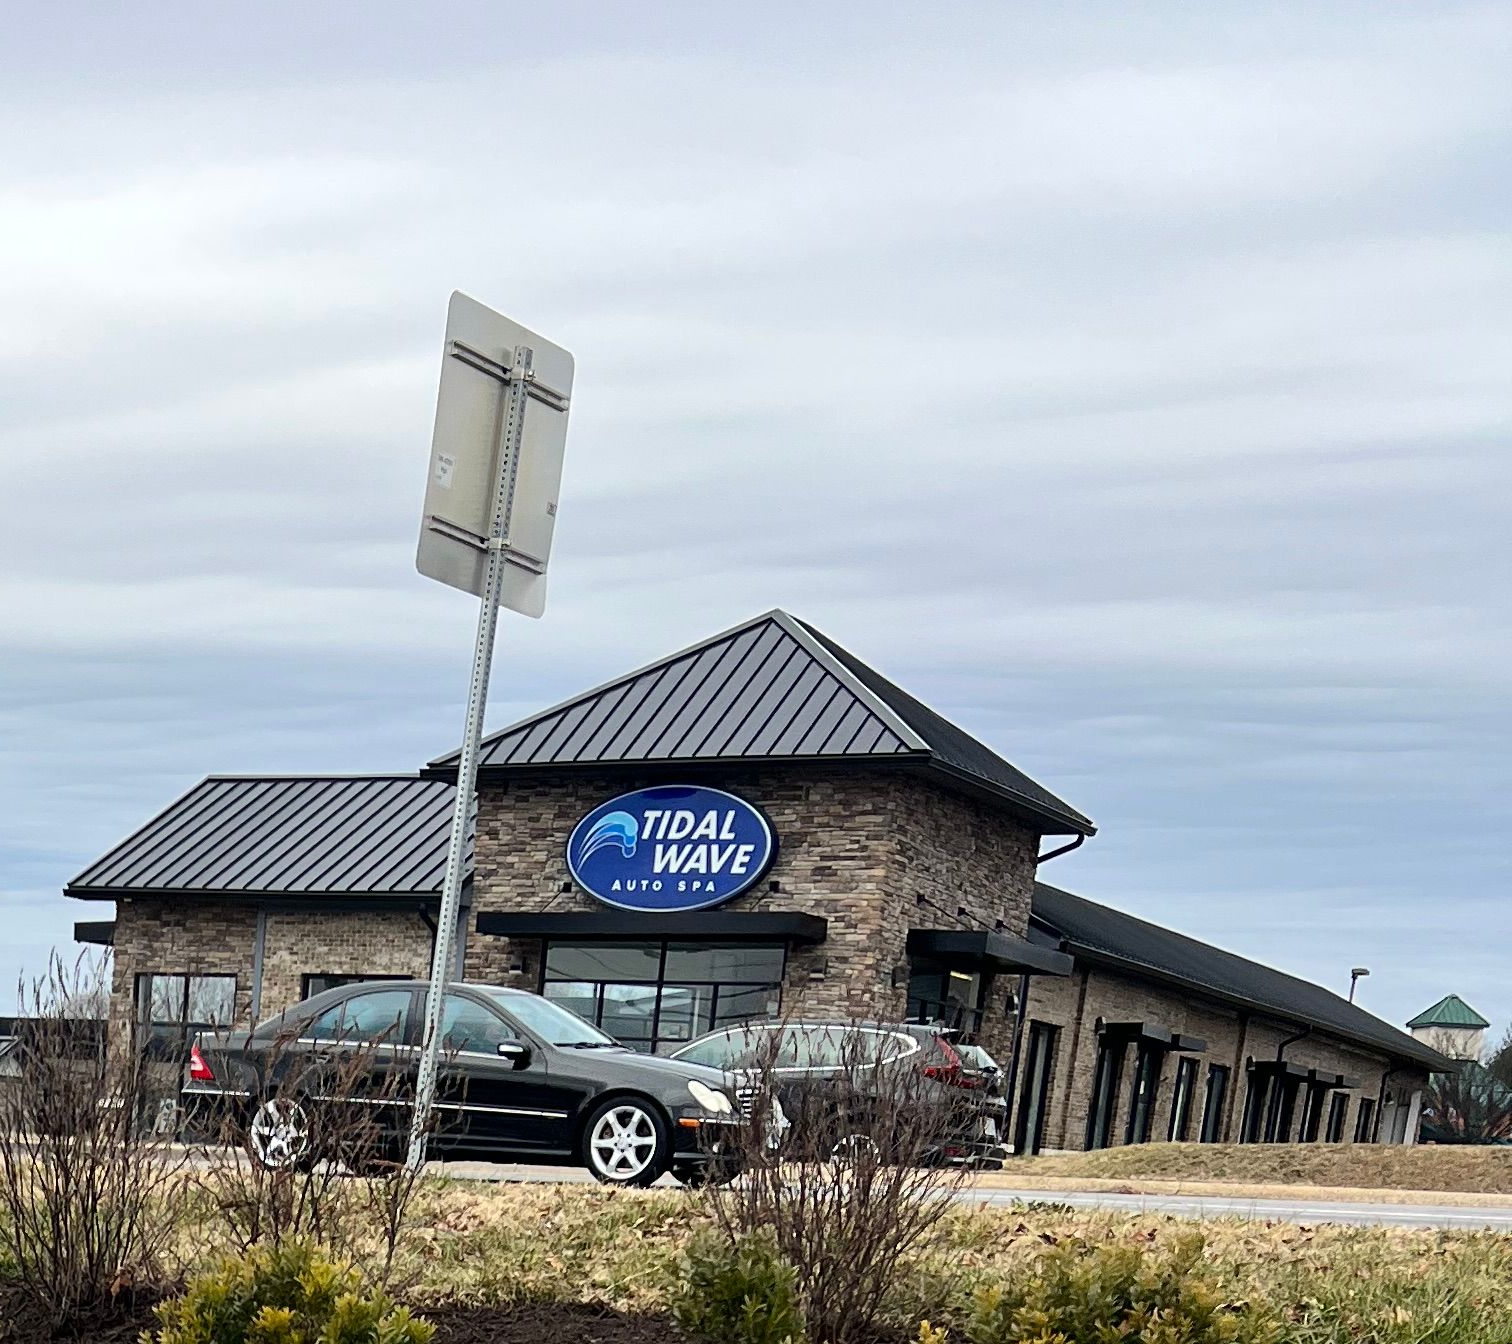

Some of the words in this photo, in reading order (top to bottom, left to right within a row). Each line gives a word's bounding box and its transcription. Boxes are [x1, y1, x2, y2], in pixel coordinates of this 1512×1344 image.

[641, 809, 736, 840] TIDAL
[652, 844, 755, 875] WAVE
[611, 879, 663, 892] AUTO
[677, 880, 716, 892] SPA
